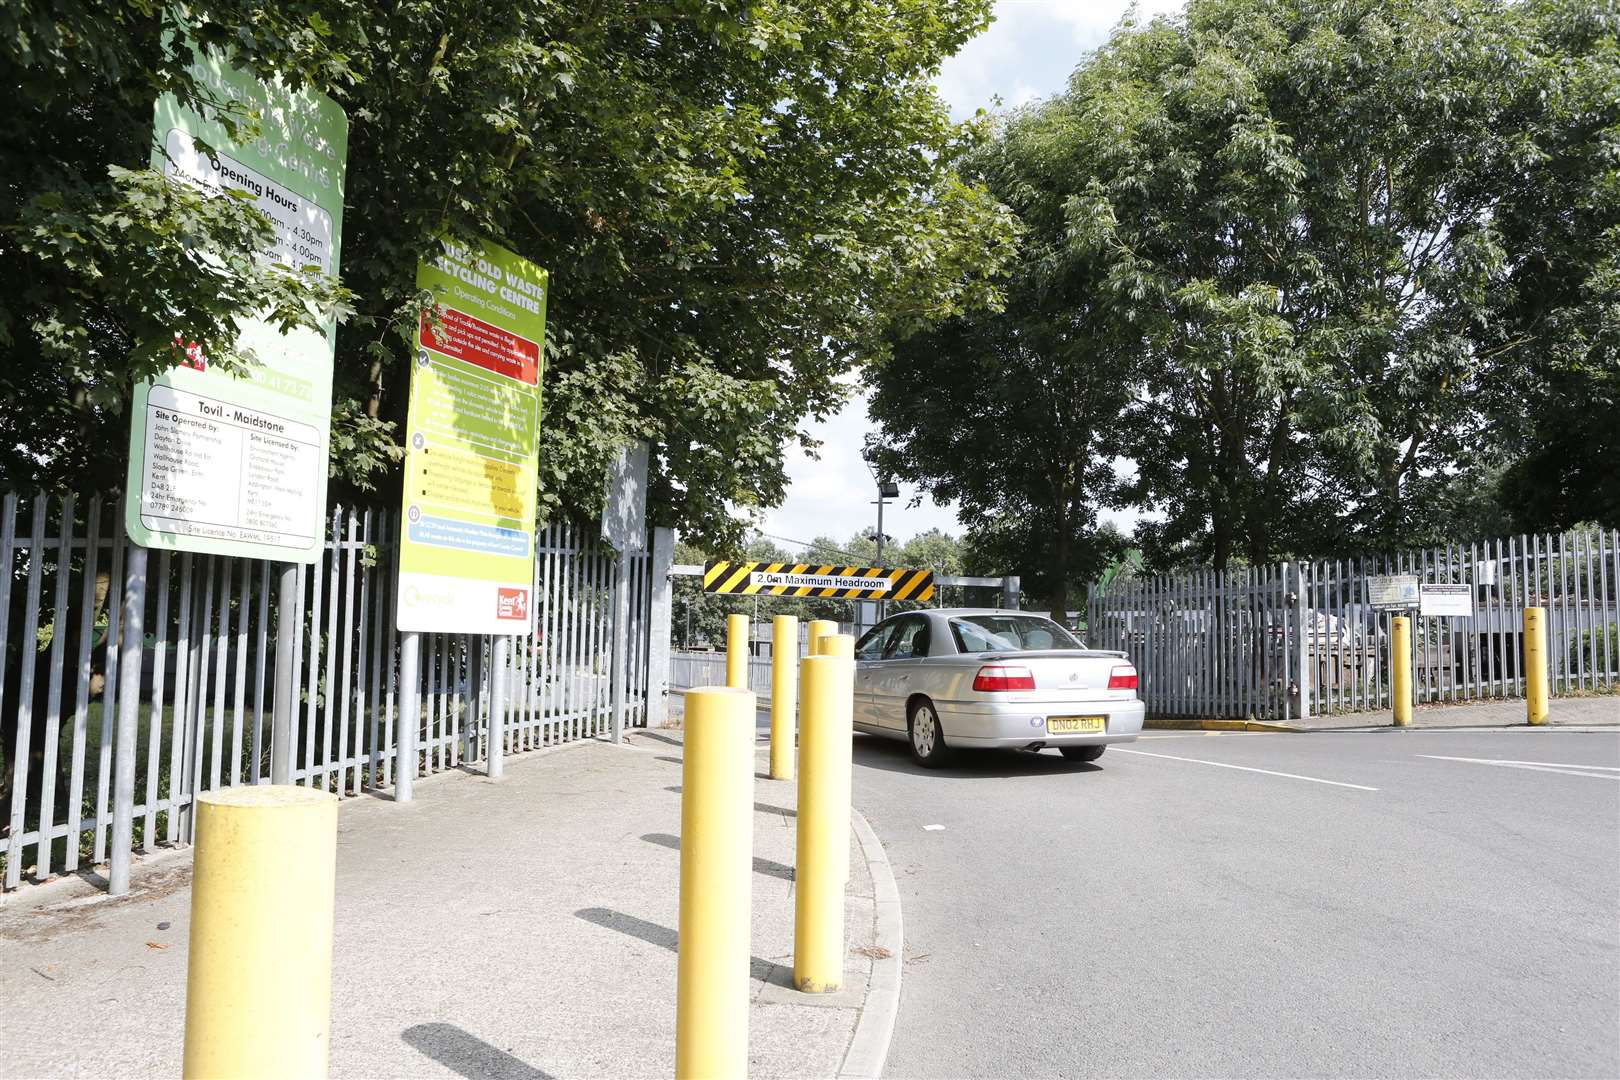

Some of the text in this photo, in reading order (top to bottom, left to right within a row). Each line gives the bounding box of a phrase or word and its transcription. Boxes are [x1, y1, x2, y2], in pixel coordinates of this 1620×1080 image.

[211, 157, 298, 212] Opening Hours
[293, 226, 323, 248] 4.30pm
[292, 241, 322, 264] 4.00pm
[437, 256, 539, 314] ECYCLING CENTRE
[506, 271, 544, 301] WASTE
[454, 285, 516, 320] Operating Conditions
[155, 410, 170, 421] Site
[171, 414, 207, 430] Operated
[198, 401, 223, 418] Tovil
[234, 411, 285, 433] Maidstone
[250, 433, 262, 442] Site
[263, 436, 289, 449] Licensed
[757, 573, 885, 589] 2.0m Maximum Headroom
[1052, 718, 1101, 731] DN02 RHJ
